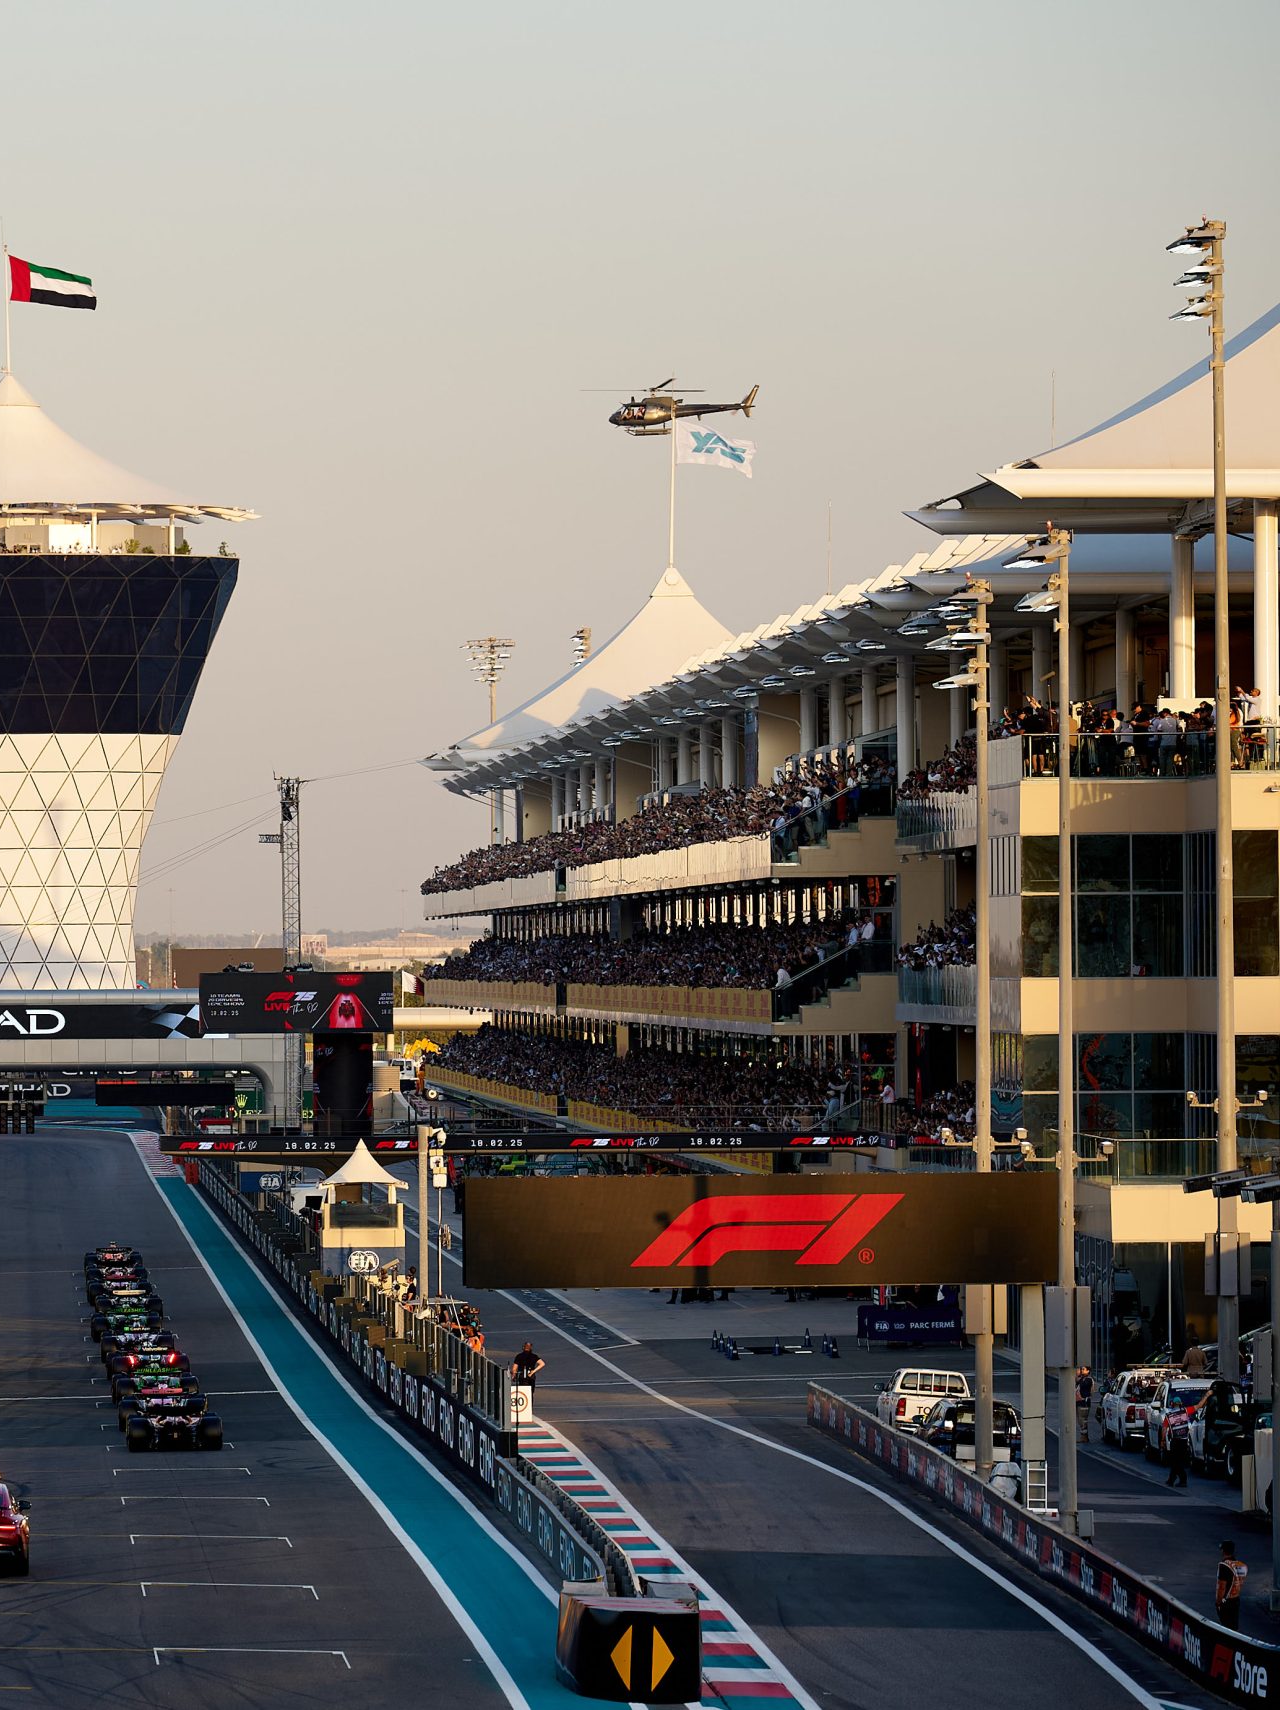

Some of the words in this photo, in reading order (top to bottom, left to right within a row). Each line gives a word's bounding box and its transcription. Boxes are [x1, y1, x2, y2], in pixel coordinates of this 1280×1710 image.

[285, 1141, 336, 1150] 18.02.25
[471, 1138, 523, 1147] 18.02.25
[690, 1137, 742, 1145] 18.02.25
[261, 1175, 280, 1189] FIA
[630, 1193, 905, 1267] F1
[350, 1254, 376, 1270] FIA
[875, 1322, 889, 1330] FIA
[931, 1320, 955, 1329] FERMÉ
[510, 1397, 525, 1407] 80
[1052, 1540, 1064, 1577] Store
[1080, 1557, 1094, 1596] Store
[1112, 1577, 1128, 1618] Store
[1147, 1599, 1163, 1642] Store
[1184, 1624, 1201, 1669] Store
[1233, 1651, 1268, 1698] Store
